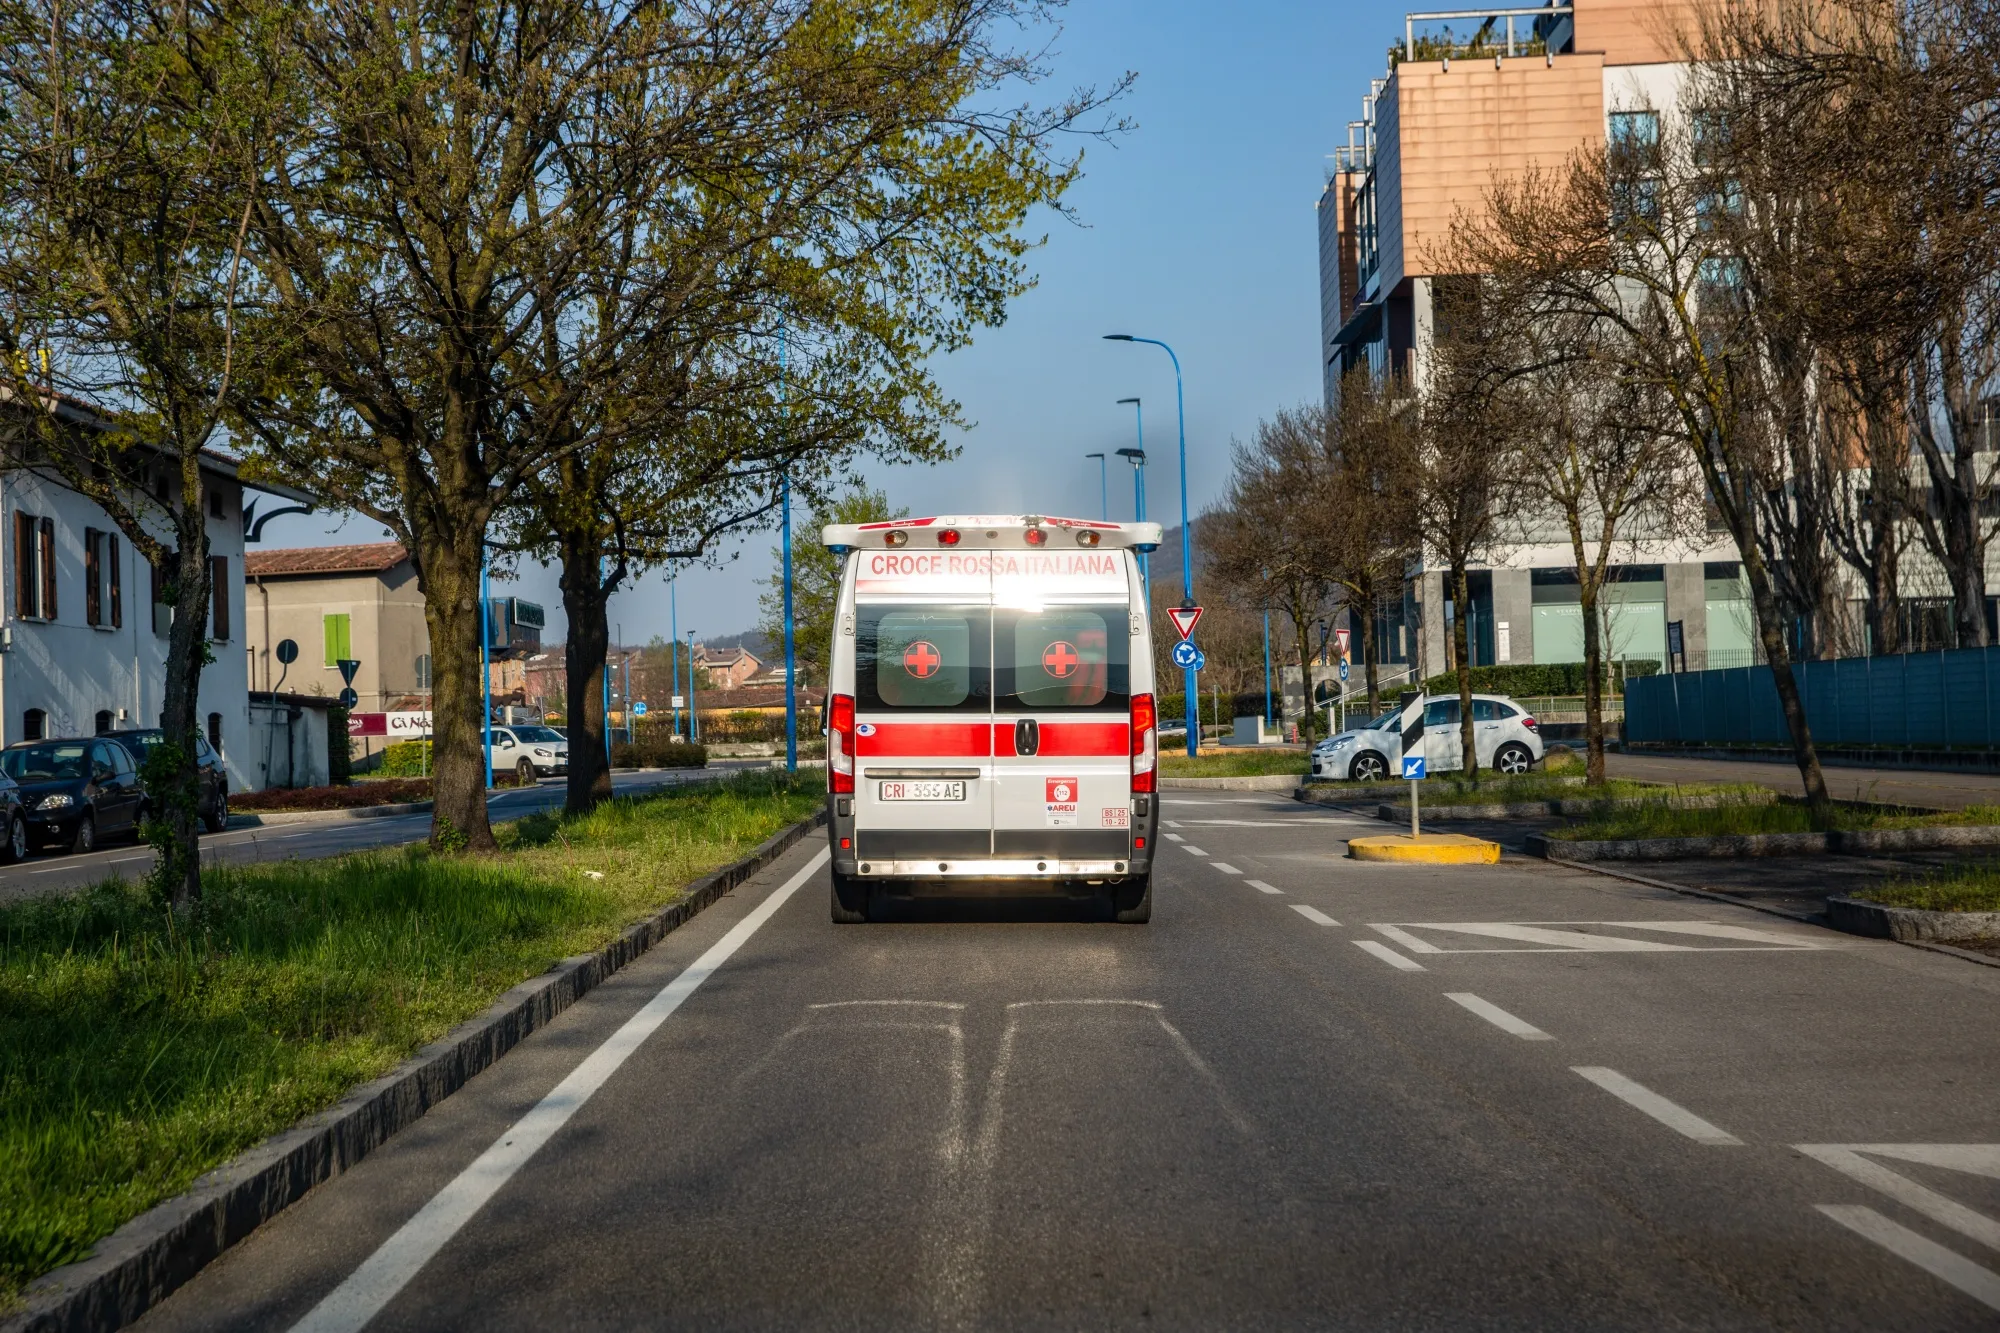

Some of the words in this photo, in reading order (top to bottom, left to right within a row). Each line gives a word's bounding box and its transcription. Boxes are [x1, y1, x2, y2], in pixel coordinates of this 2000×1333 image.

[871, 555, 943, 576] CROCE
[949, 555, 1018, 576] ROSSA
[1024, 555, 1117, 576] ITALIANA
[884, 783, 905, 798] CRI
[1053, 804, 1076, 812] AREU
[1117, 809, 1126, 817] 25
